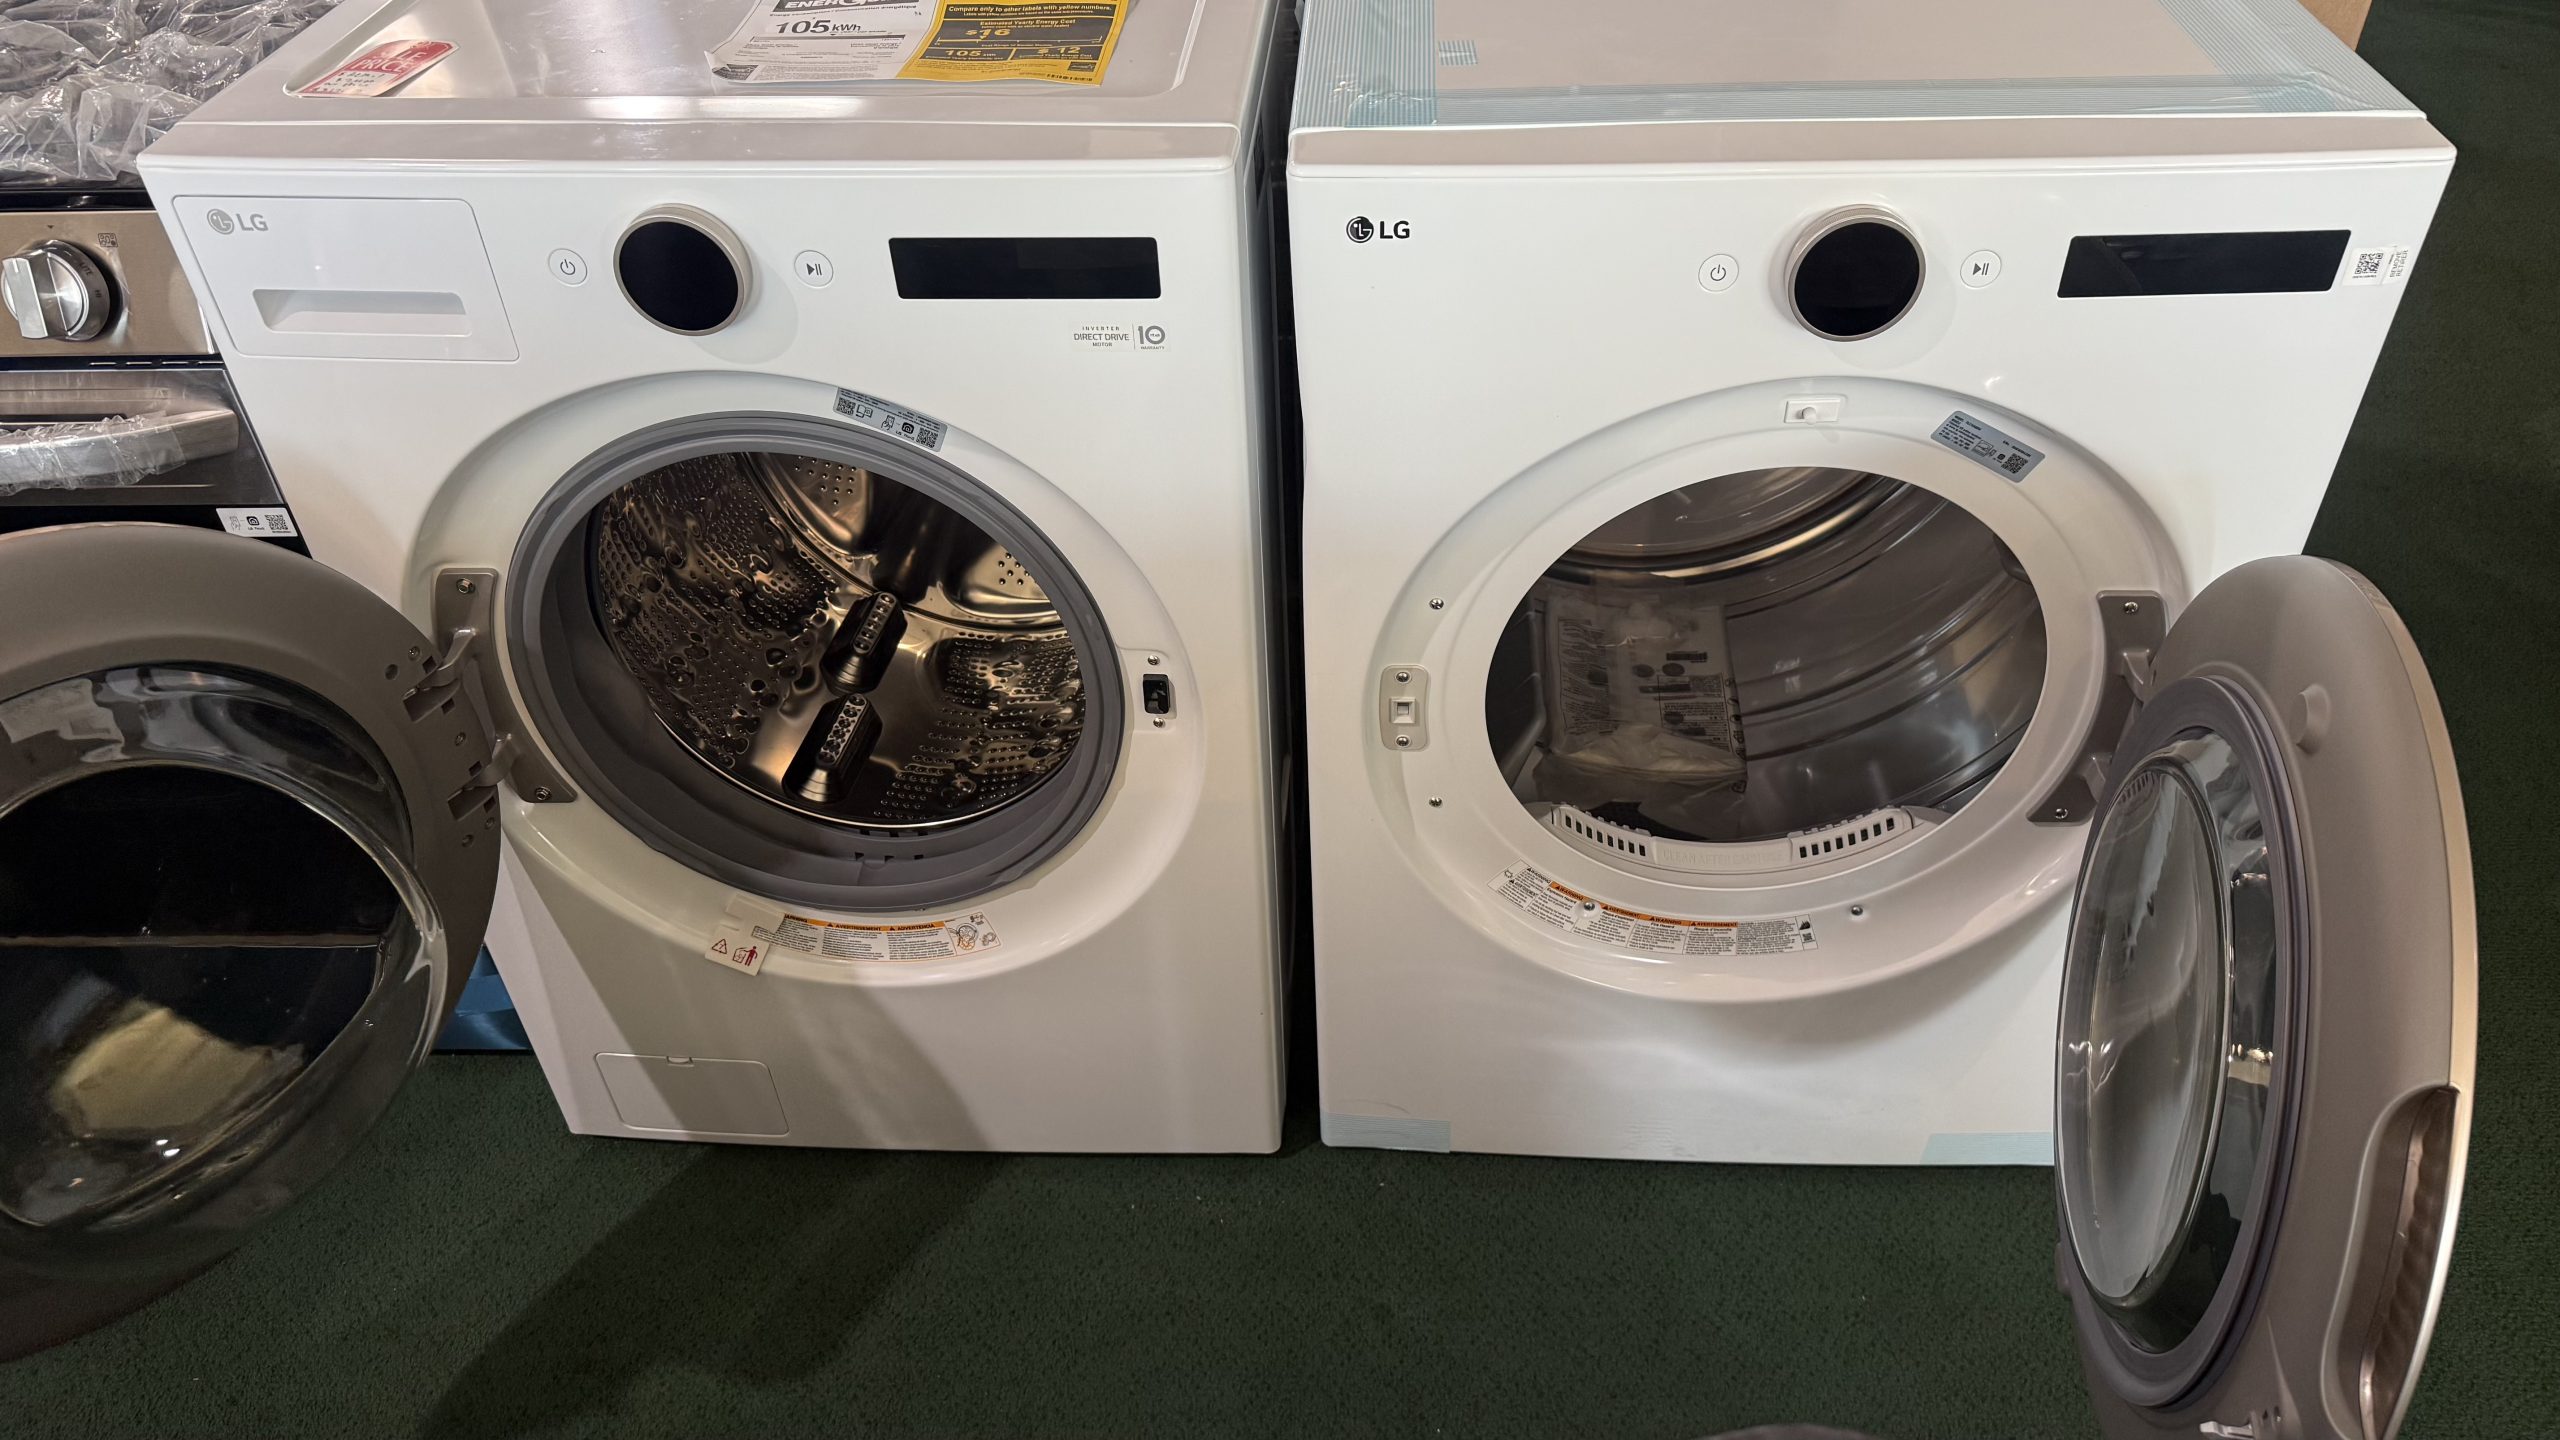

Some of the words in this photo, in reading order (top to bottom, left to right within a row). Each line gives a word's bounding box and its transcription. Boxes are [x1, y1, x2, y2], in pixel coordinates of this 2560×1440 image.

[776, 20, 831, 34] 105
[832, 23, 861, 31] kWh
[351, 58, 412, 73] PRICE
[236, 213, 268, 231] LG
[1380, 220, 1410, 239] LG
[1073, 333, 1103, 341] DIRECT
[1104, 333, 1130, 341] DRIVE
[1138, 325, 1166, 345] 10
[1559, 887, 1584, 901] WARNING
[1655, 917, 1682, 925] WARNING
